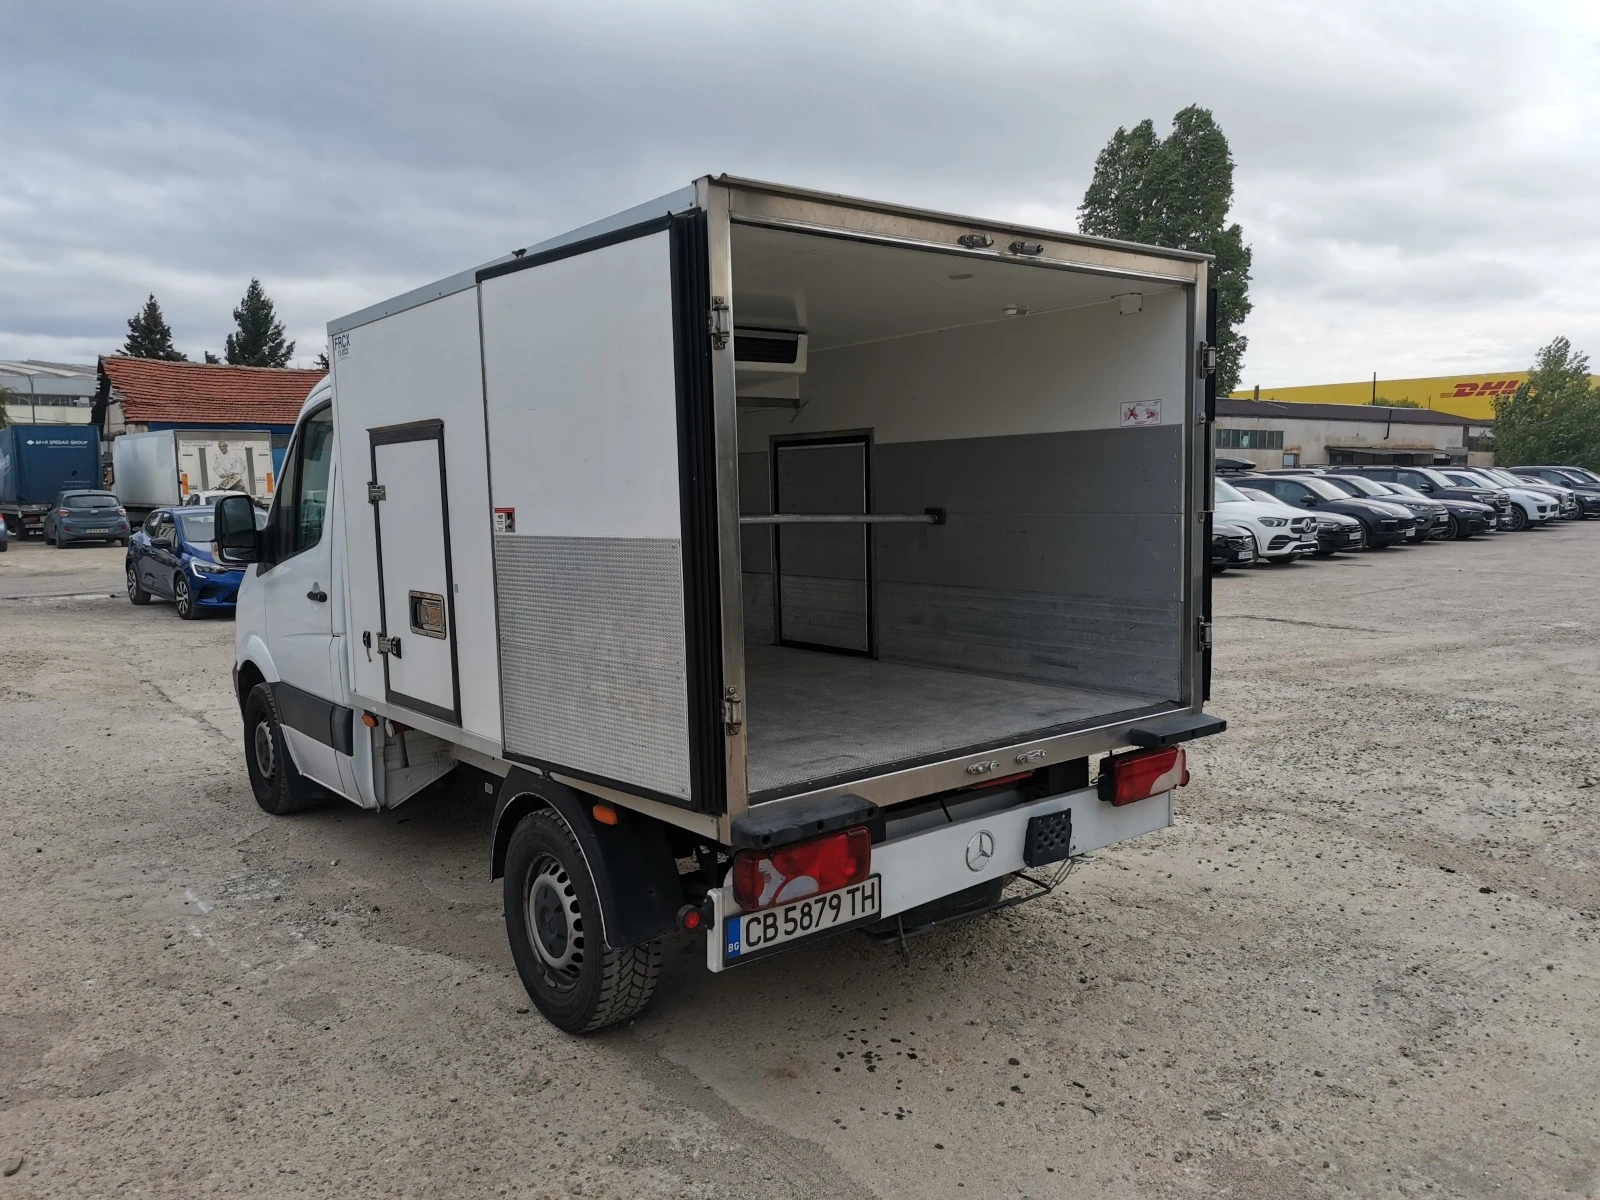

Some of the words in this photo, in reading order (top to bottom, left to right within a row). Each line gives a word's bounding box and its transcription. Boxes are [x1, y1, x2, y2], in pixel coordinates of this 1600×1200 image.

[1453, 380, 1519, 397] DHL
[745, 912, 778, 947] CB
[784, 893, 842, 936] 5879
[847, 881, 875, 917] TH
[728, 941, 740, 953] BG
